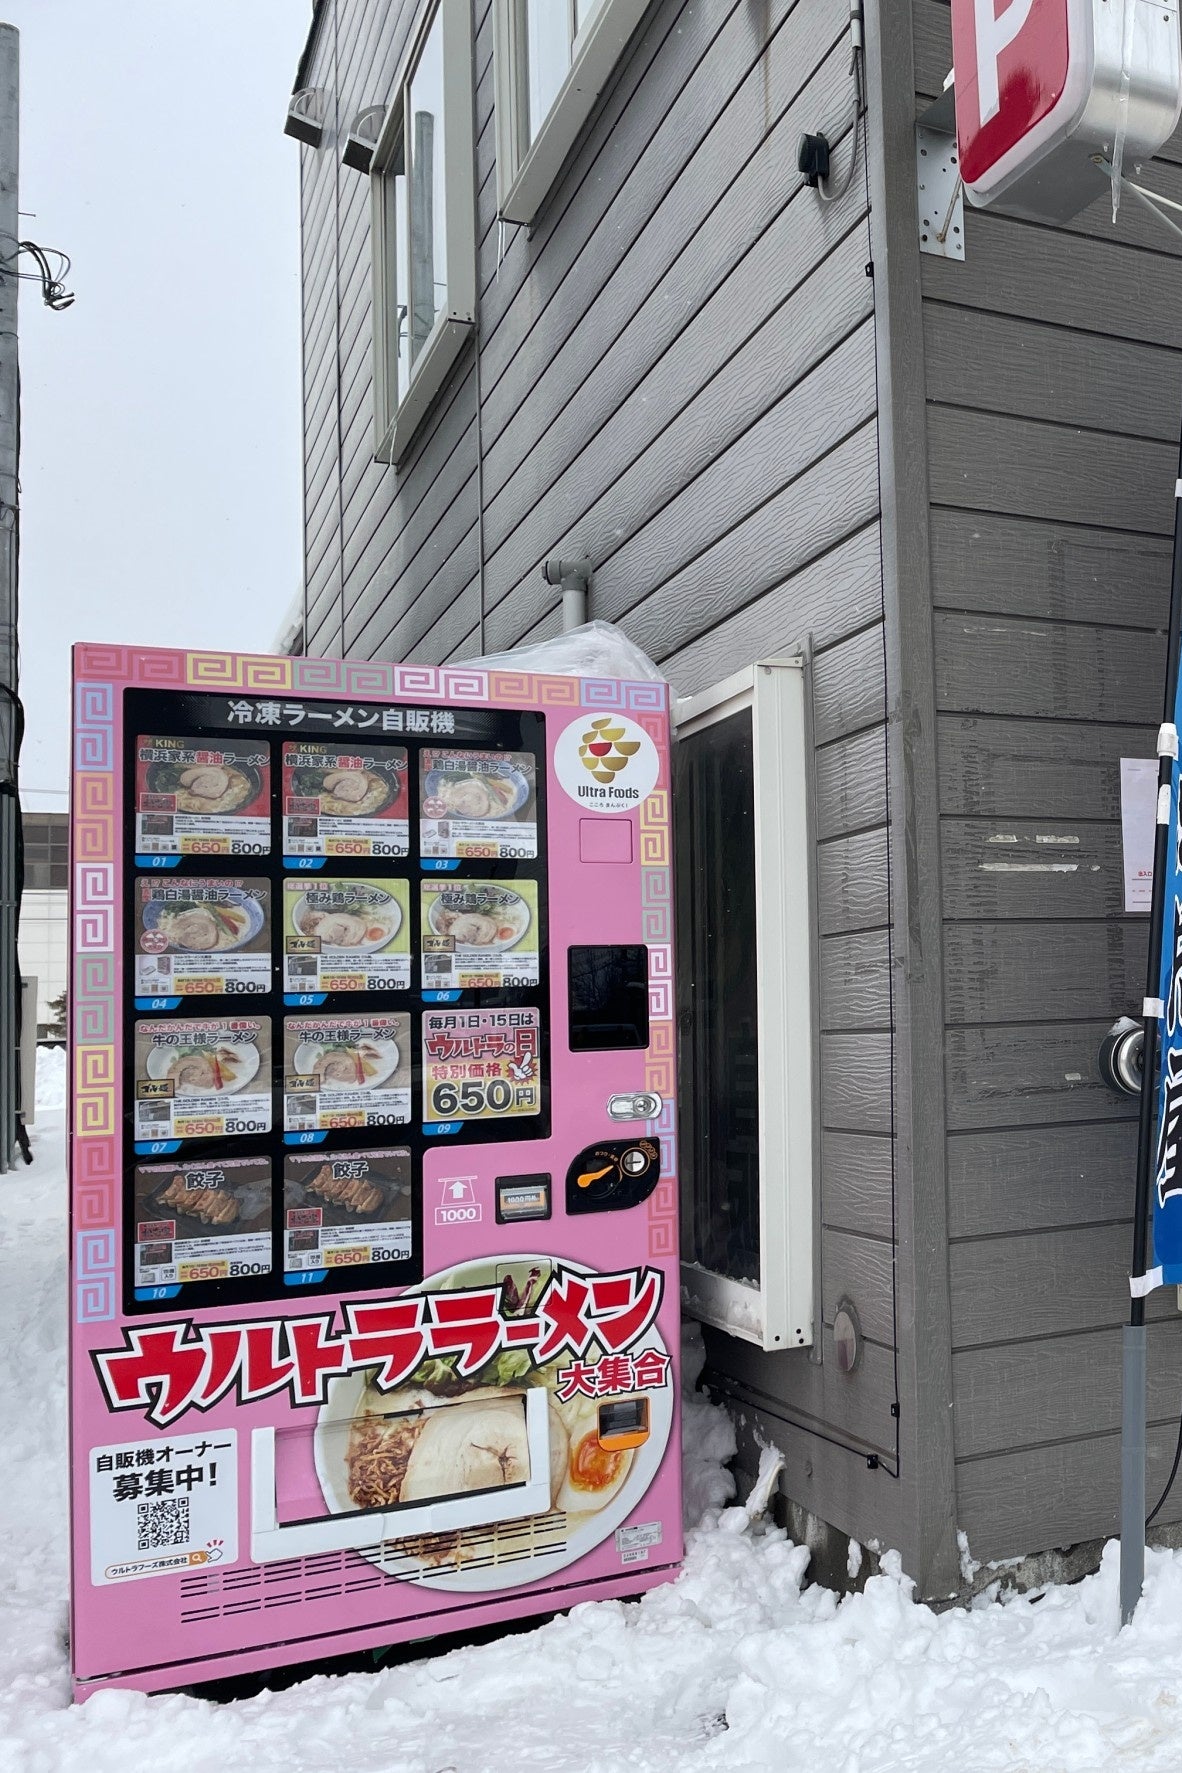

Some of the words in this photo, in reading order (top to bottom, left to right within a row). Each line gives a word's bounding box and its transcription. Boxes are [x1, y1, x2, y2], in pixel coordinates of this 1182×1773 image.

[227, 700, 455, 735] 冷凍ラーメン自販機
[155, 739, 185, 749] KING
[300, 744, 327, 754] KING
[139, 749, 270, 766] 横浜家系醤油ラーメン
[285, 753, 408, 770] 横浜家系醤油ラーメン
[578, 785, 606, 798] Ultra
[608, 786, 639, 799] Foods
[500, 847, 534, 858] 800円
[152, 857, 167, 867] 01
[299, 859, 313, 868] 02
[435, 860, 448, 870] 03
[151, 888, 267, 901] 鶏白湯醤油ラーメン
[305, 891, 391, 905] 極み鶏ラーメン
[441, 893, 519, 905] 極み鶏ラーメン
[224, 981, 266, 993] 800円
[367, 978, 405, 990] 800円
[503, 976, 537, 987] 800円
[300, 995, 313, 1004] 05
[437, 991, 450, 1001] 06
[151, 998, 167, 1009] 04
[429, 1013, 534, 1029] 毎月1日・15日は
[152, 1031, 257, 1046] 牛の王様ラーメン
[300, 1028, 396, 1044] 牛の王様ラーメン
[425, 1027, 538, 1060] ウルトラの日
[431, 1063, 502, 1080] 特別価格
[432, 1079, 536, 1115] 650円
[367, 1113, 405, 1125] 800円
[225, 1120, 266, 1133] 800円
[437, 1124, 451, 1134] 09
[300, 1133, 314, 1143] 08
[151, 1142, 167, 1153] 07
[332, 1161, 368, 1180] 餃子
[185, 1171, 224, 1190] 餃子
[441, 1208, 476, 1221] 1000
[372, 1249, 410, 1263] 800円
[229, 1263, 270, 1276] 800円
[301, 1273, 314, 1283] 11
[152, 1288, 166, 1298] 10
[89, 1266, 665, 1430] ウルトララーメン
[556, 1349, 671, 1403] 大集合
[96, 1441, 232, 1473] 自販機オーナー
[113, 1462, 217, 1502] 募集中!
[111, 1556, 188, 1575] ウルトラフーズ株式会社
